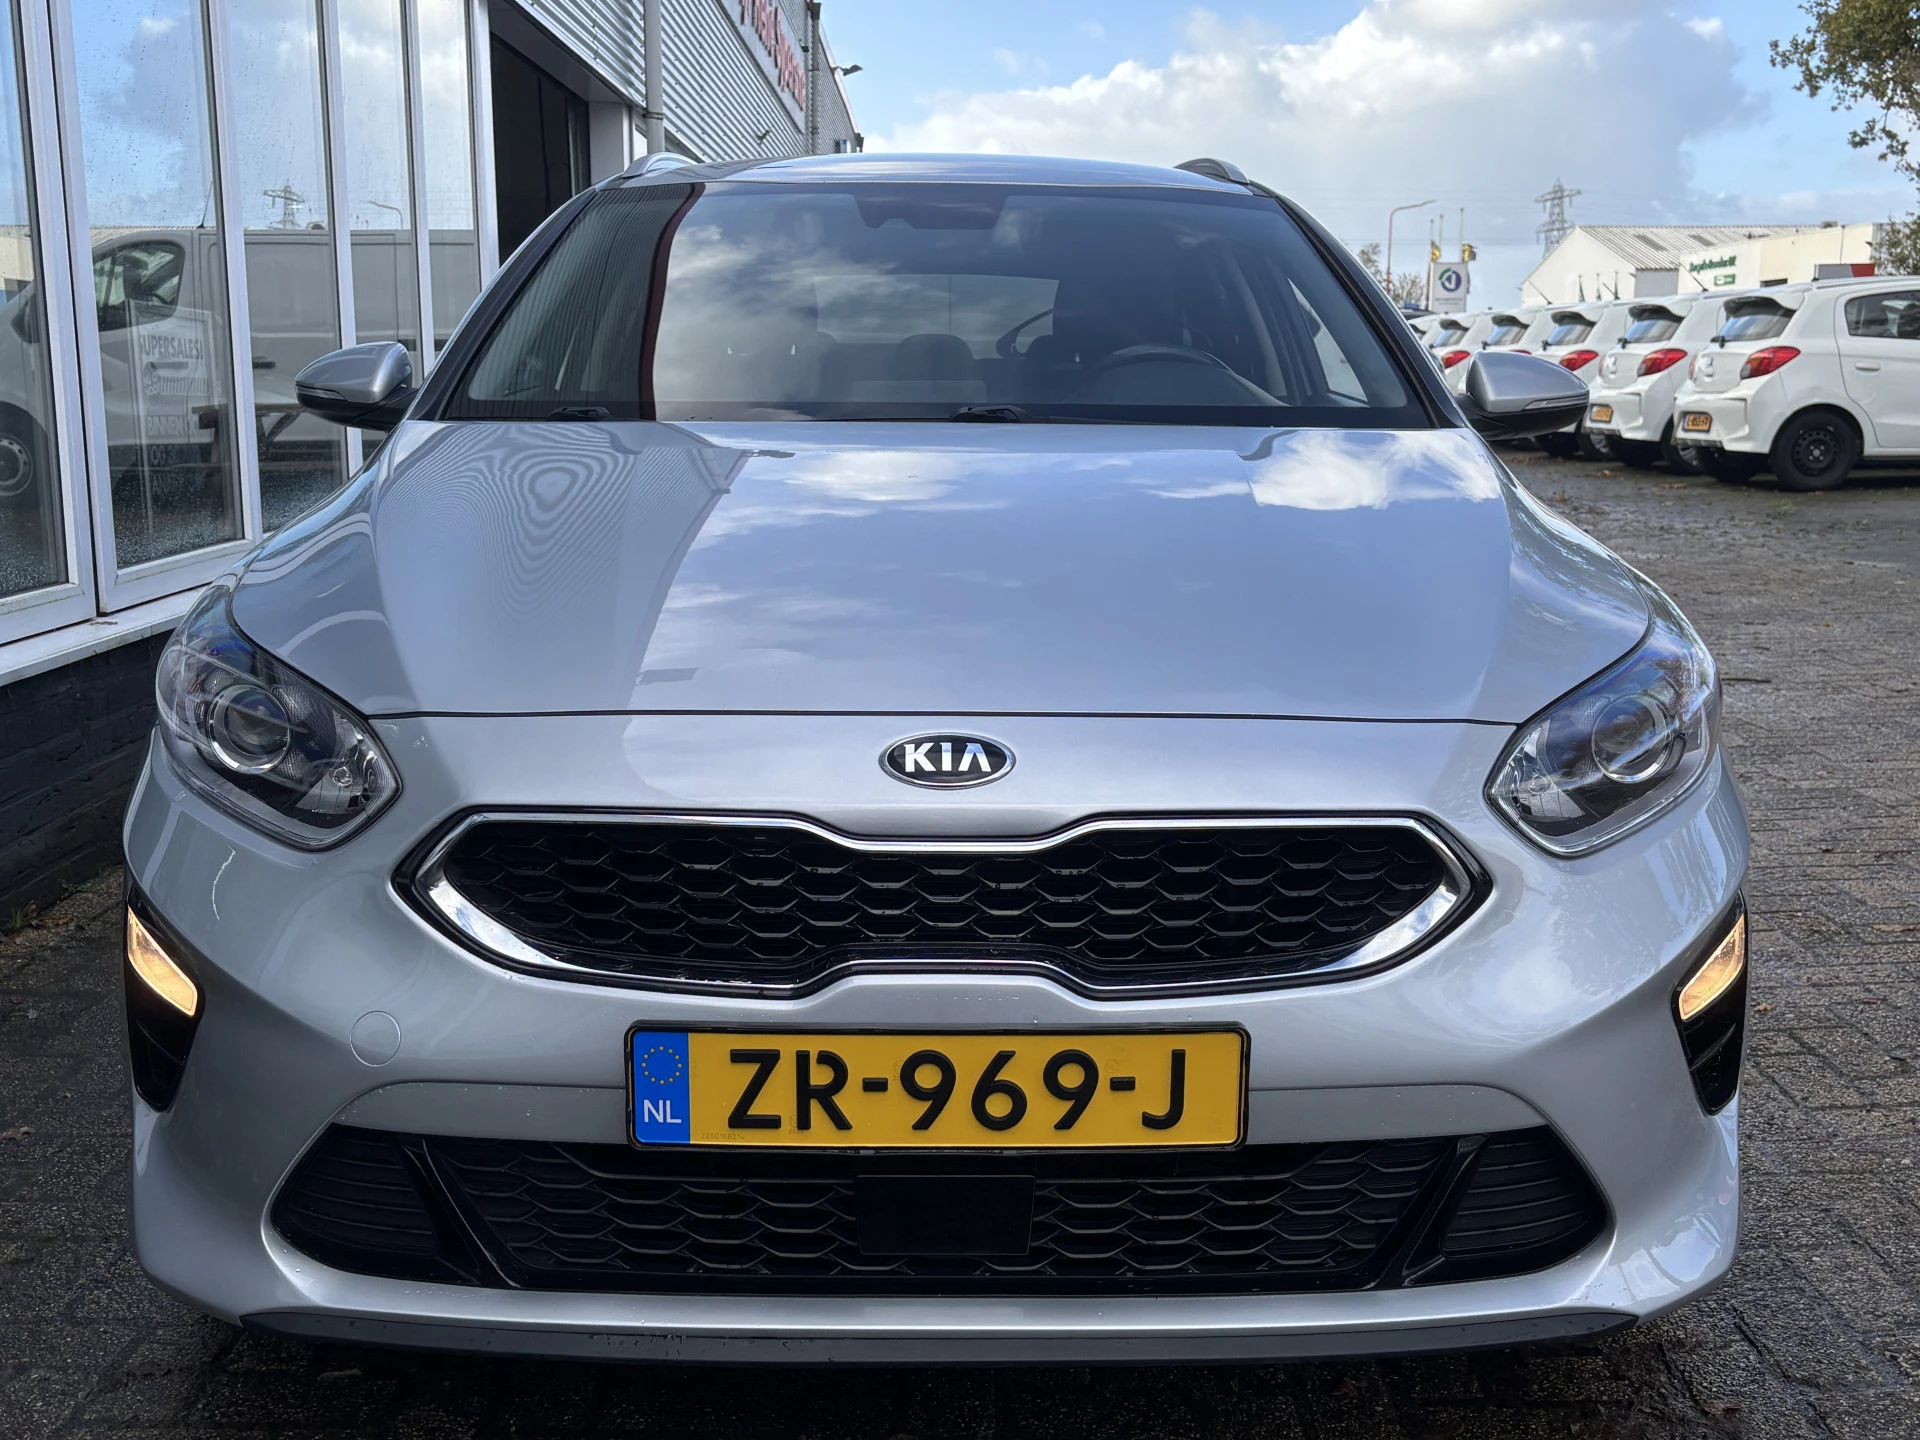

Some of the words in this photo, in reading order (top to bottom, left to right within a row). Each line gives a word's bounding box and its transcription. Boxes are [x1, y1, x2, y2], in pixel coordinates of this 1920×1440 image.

[904, 742, 992, 772] KIA
[728, 1048, 1187, 1131] ZR-969-J
[643, 1099, 682, 1124] NL
